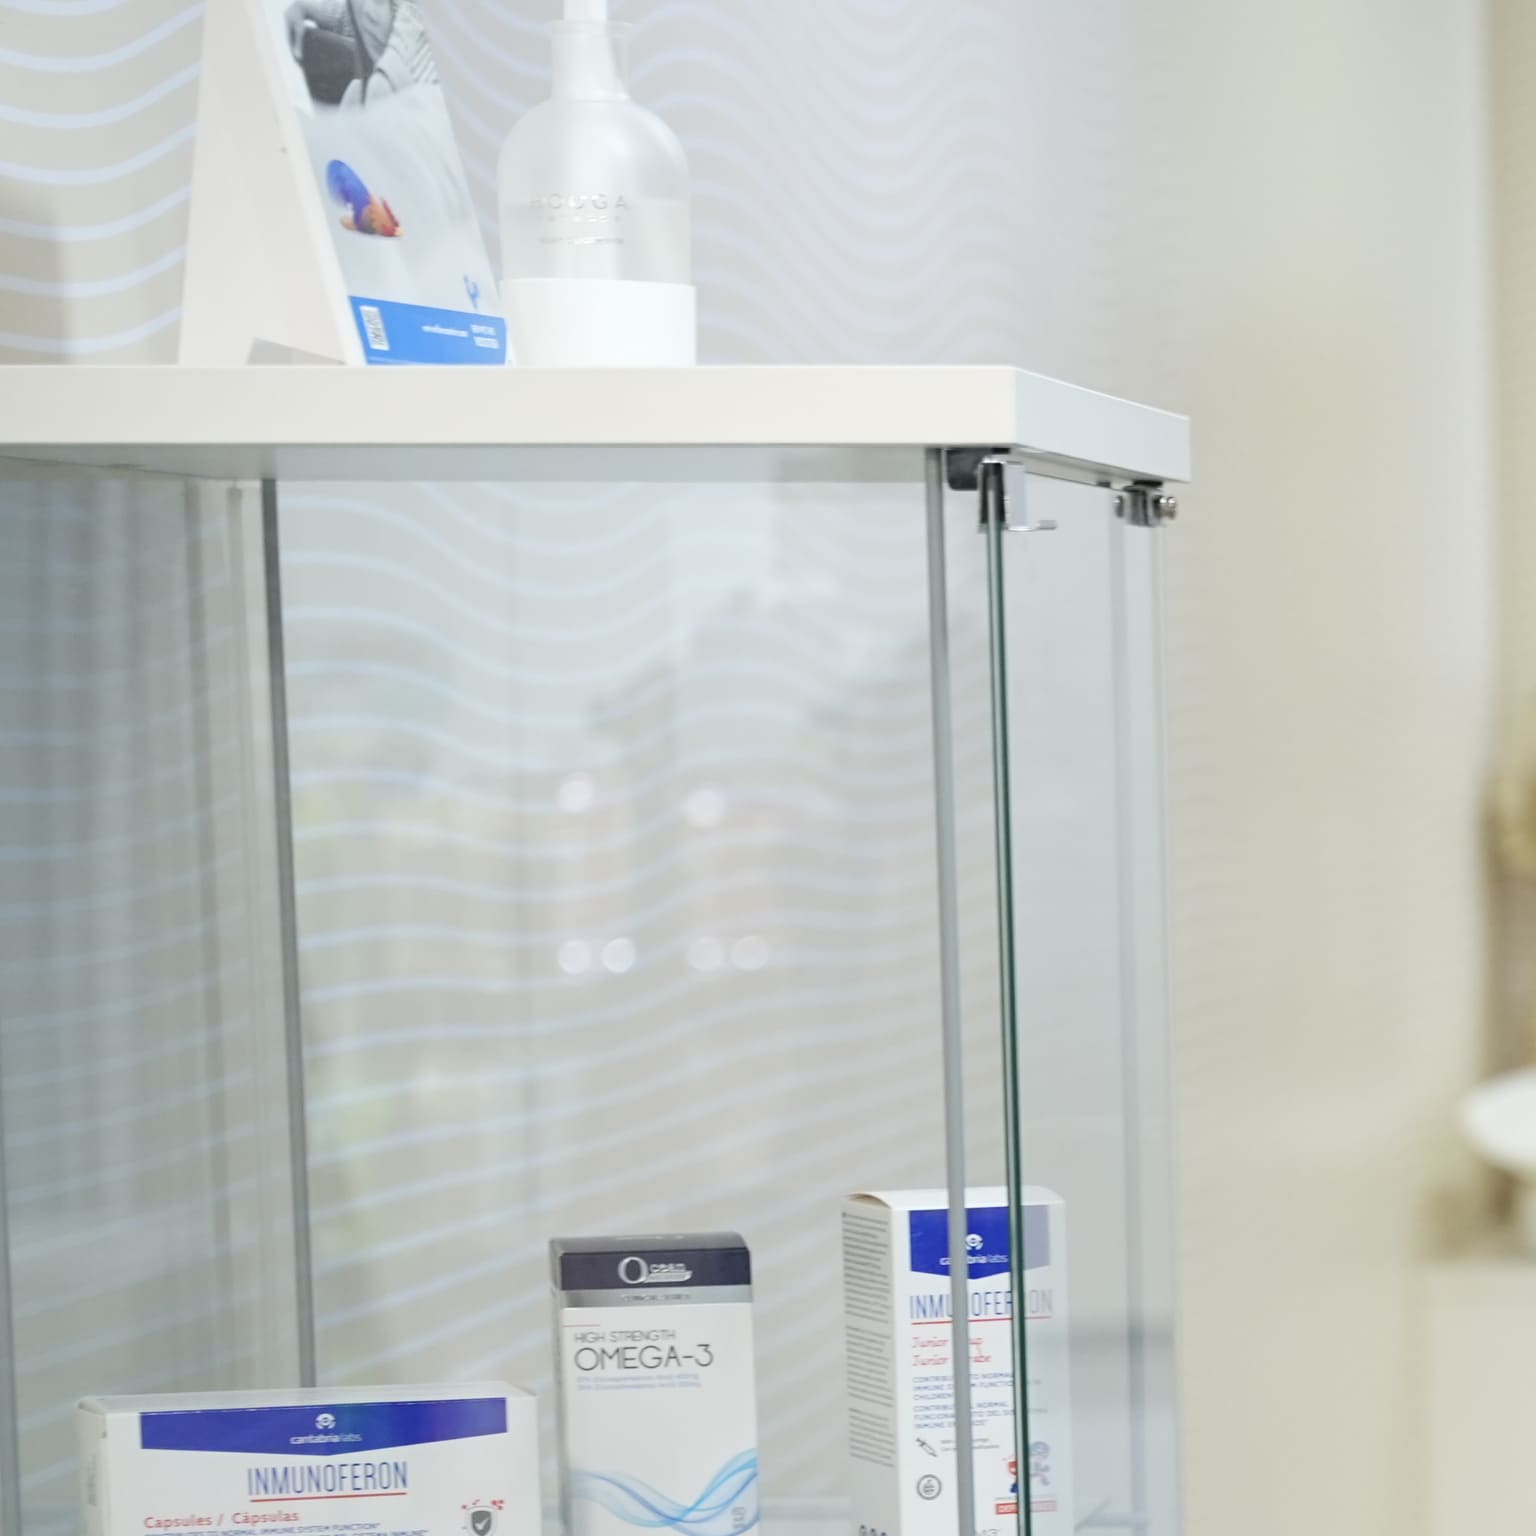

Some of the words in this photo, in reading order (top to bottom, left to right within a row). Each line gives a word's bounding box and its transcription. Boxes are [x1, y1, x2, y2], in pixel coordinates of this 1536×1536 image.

[575, 1331, 605, 1344] HIGH
[609, 1329, 677, 1343] STRENGTH
[574, 1343, 714, 1371] OMEGA-3
[247, 1461, 409, 1496] INMUNOFERON
[143, 1515, 213, 1531] Capsules
[231, 1510, 302, 1527] Cápsulas
